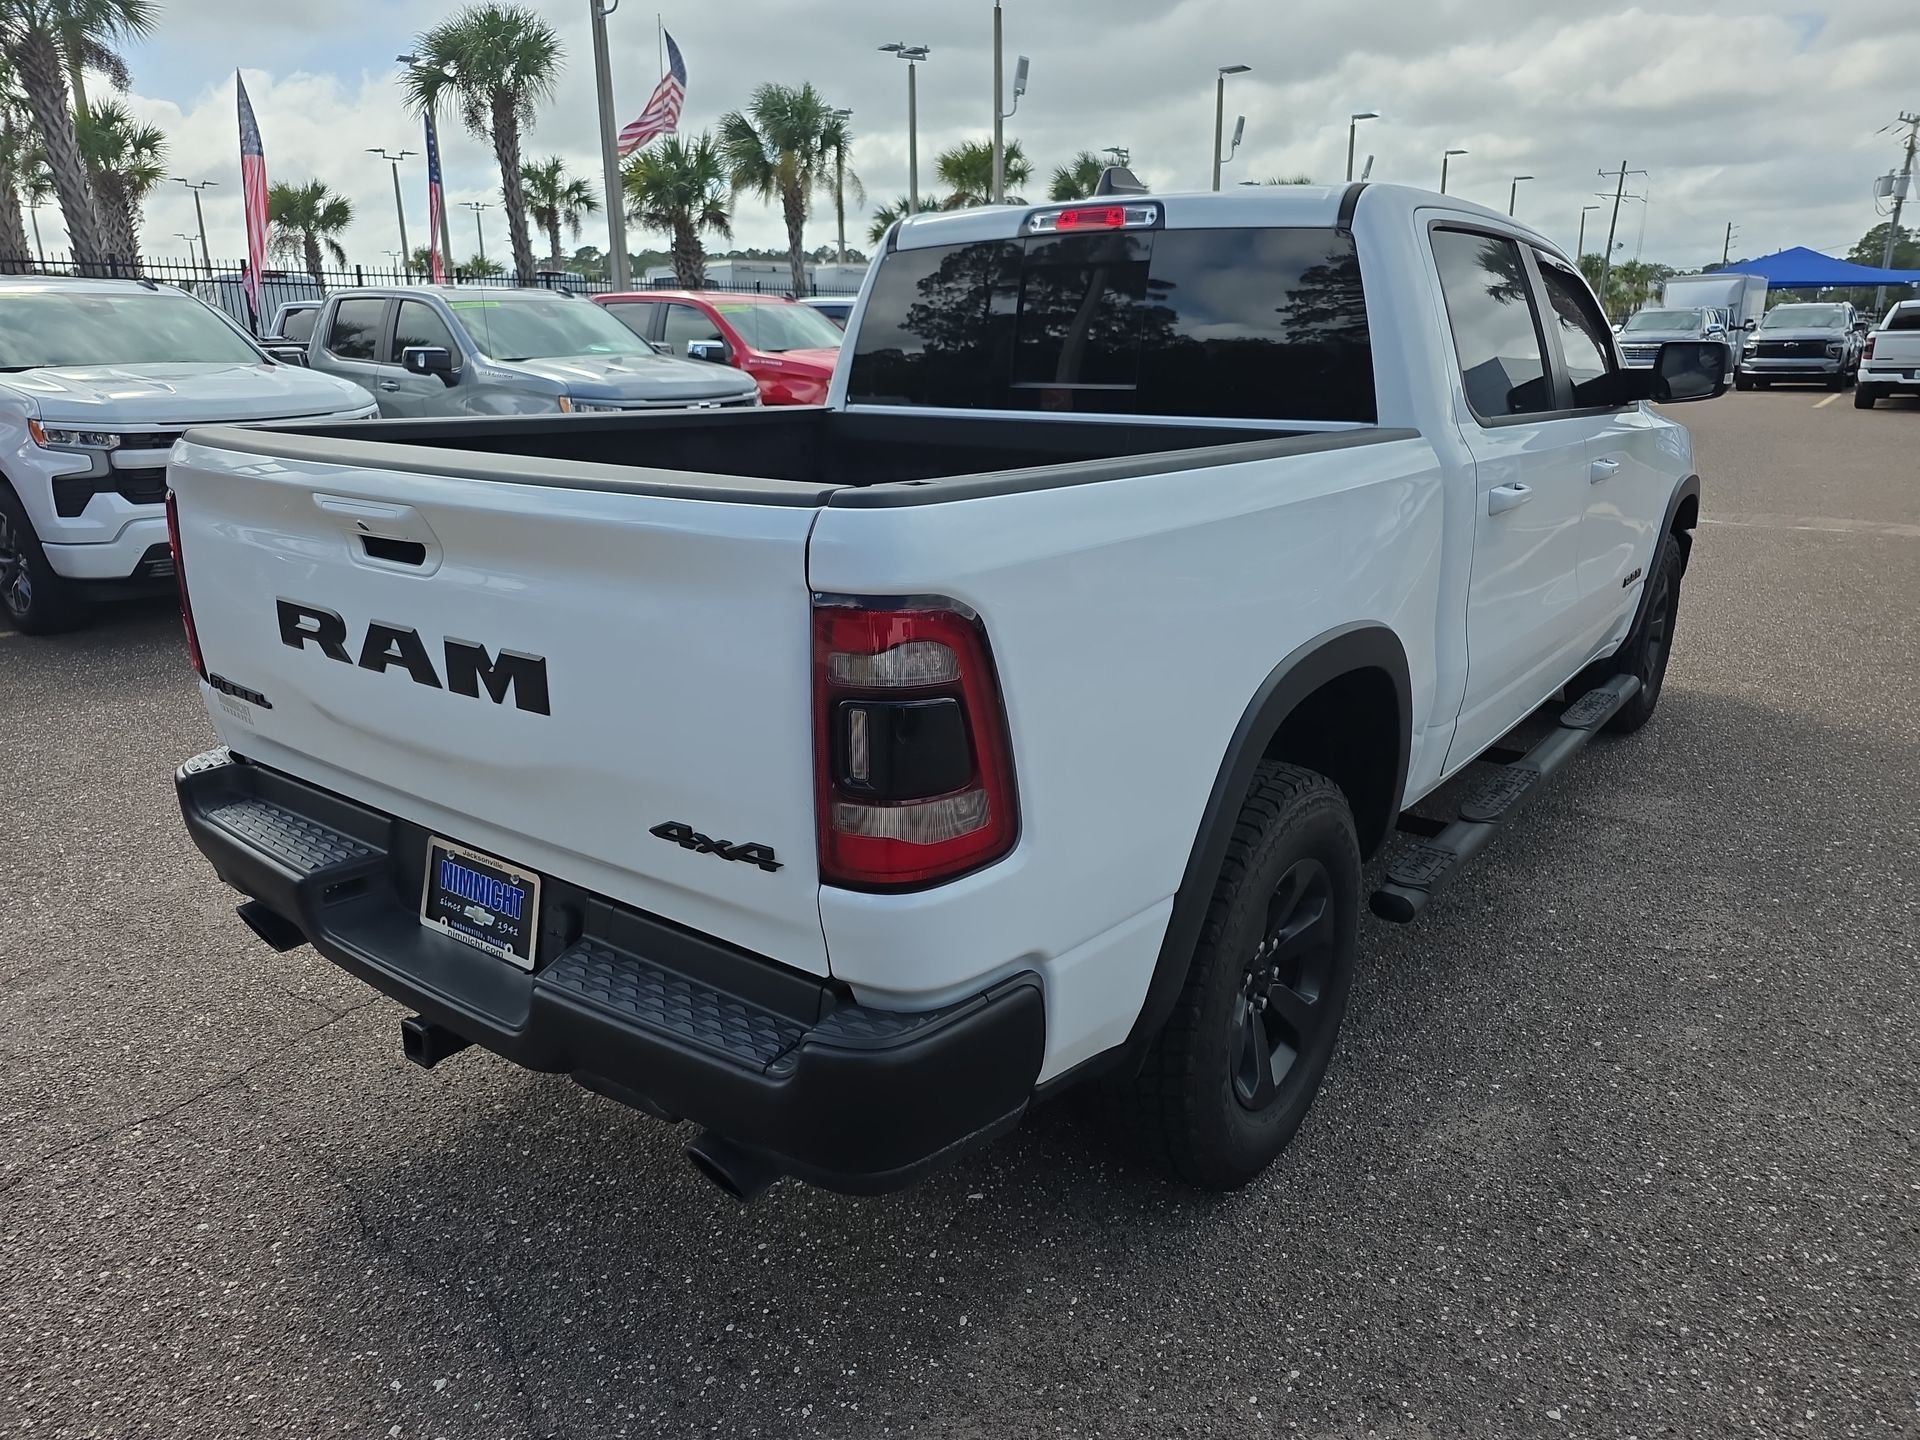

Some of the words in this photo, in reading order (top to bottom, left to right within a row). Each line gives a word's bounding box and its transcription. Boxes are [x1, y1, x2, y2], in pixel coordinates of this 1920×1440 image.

[276, 595, 551, 717] RAM
[462, 849, 504, 870] Jacksonville
[440, 859, 525, 921] NIMNICHT
[439, 896, 461, 912] since
[497, 921, 519, 937] 1941
[447, 929, 504, 958] nimnicht.com
